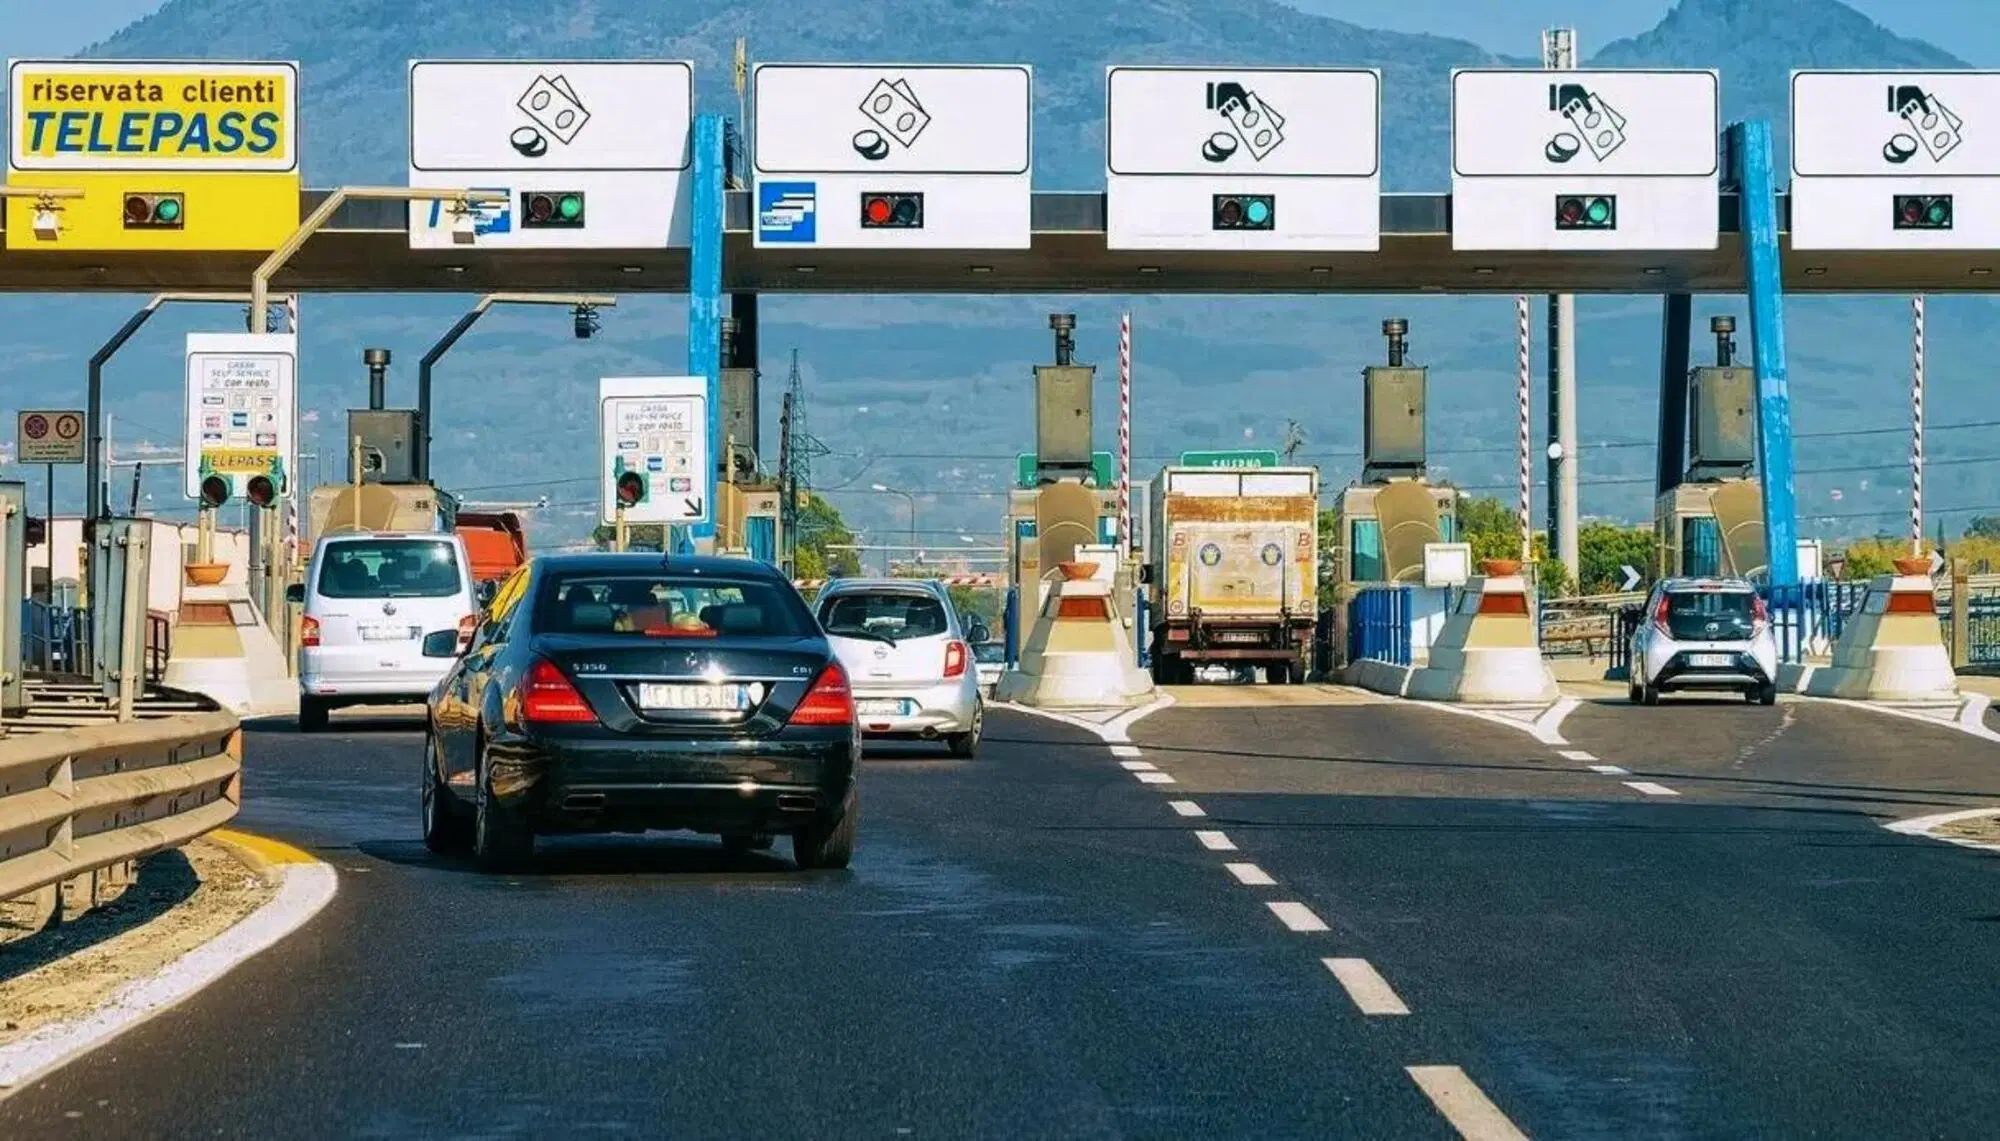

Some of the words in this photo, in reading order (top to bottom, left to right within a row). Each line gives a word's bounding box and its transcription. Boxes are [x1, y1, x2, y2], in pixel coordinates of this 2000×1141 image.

[33, 79, 163, 102] riservata
[183, 79, 274, 103] clienti
[27, 111, 279, 153] TELEPASS
[224, 379, 242, 388] con
[246, 378, 270, 388] resto
[204, 453, 277, 468] ELEPASS
